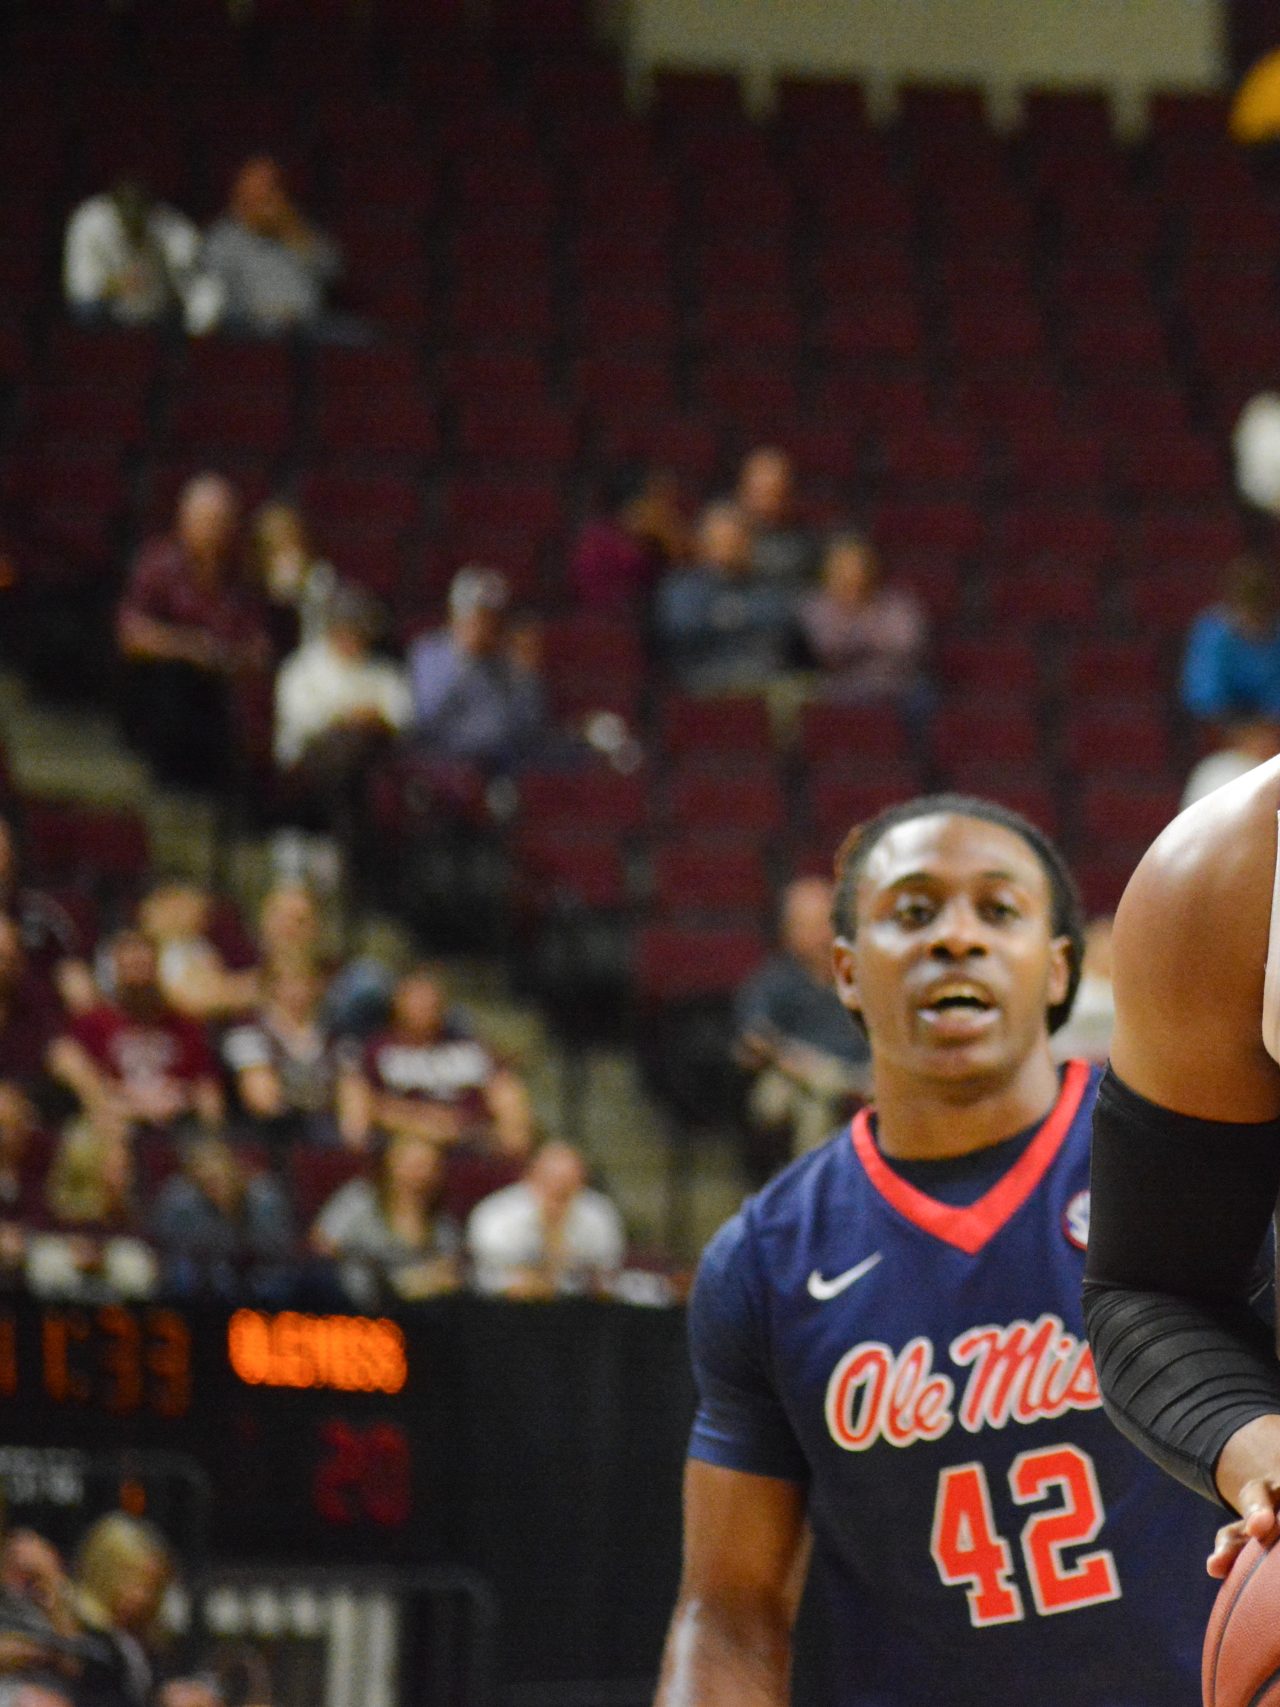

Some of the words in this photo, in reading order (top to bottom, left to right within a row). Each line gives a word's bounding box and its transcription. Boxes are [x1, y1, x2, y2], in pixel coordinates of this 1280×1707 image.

[825, 1336, 955, 1452] Ole
[949, 1312, 1104, 1434] Mis
[930, 1442, 1122, 1628] 42
